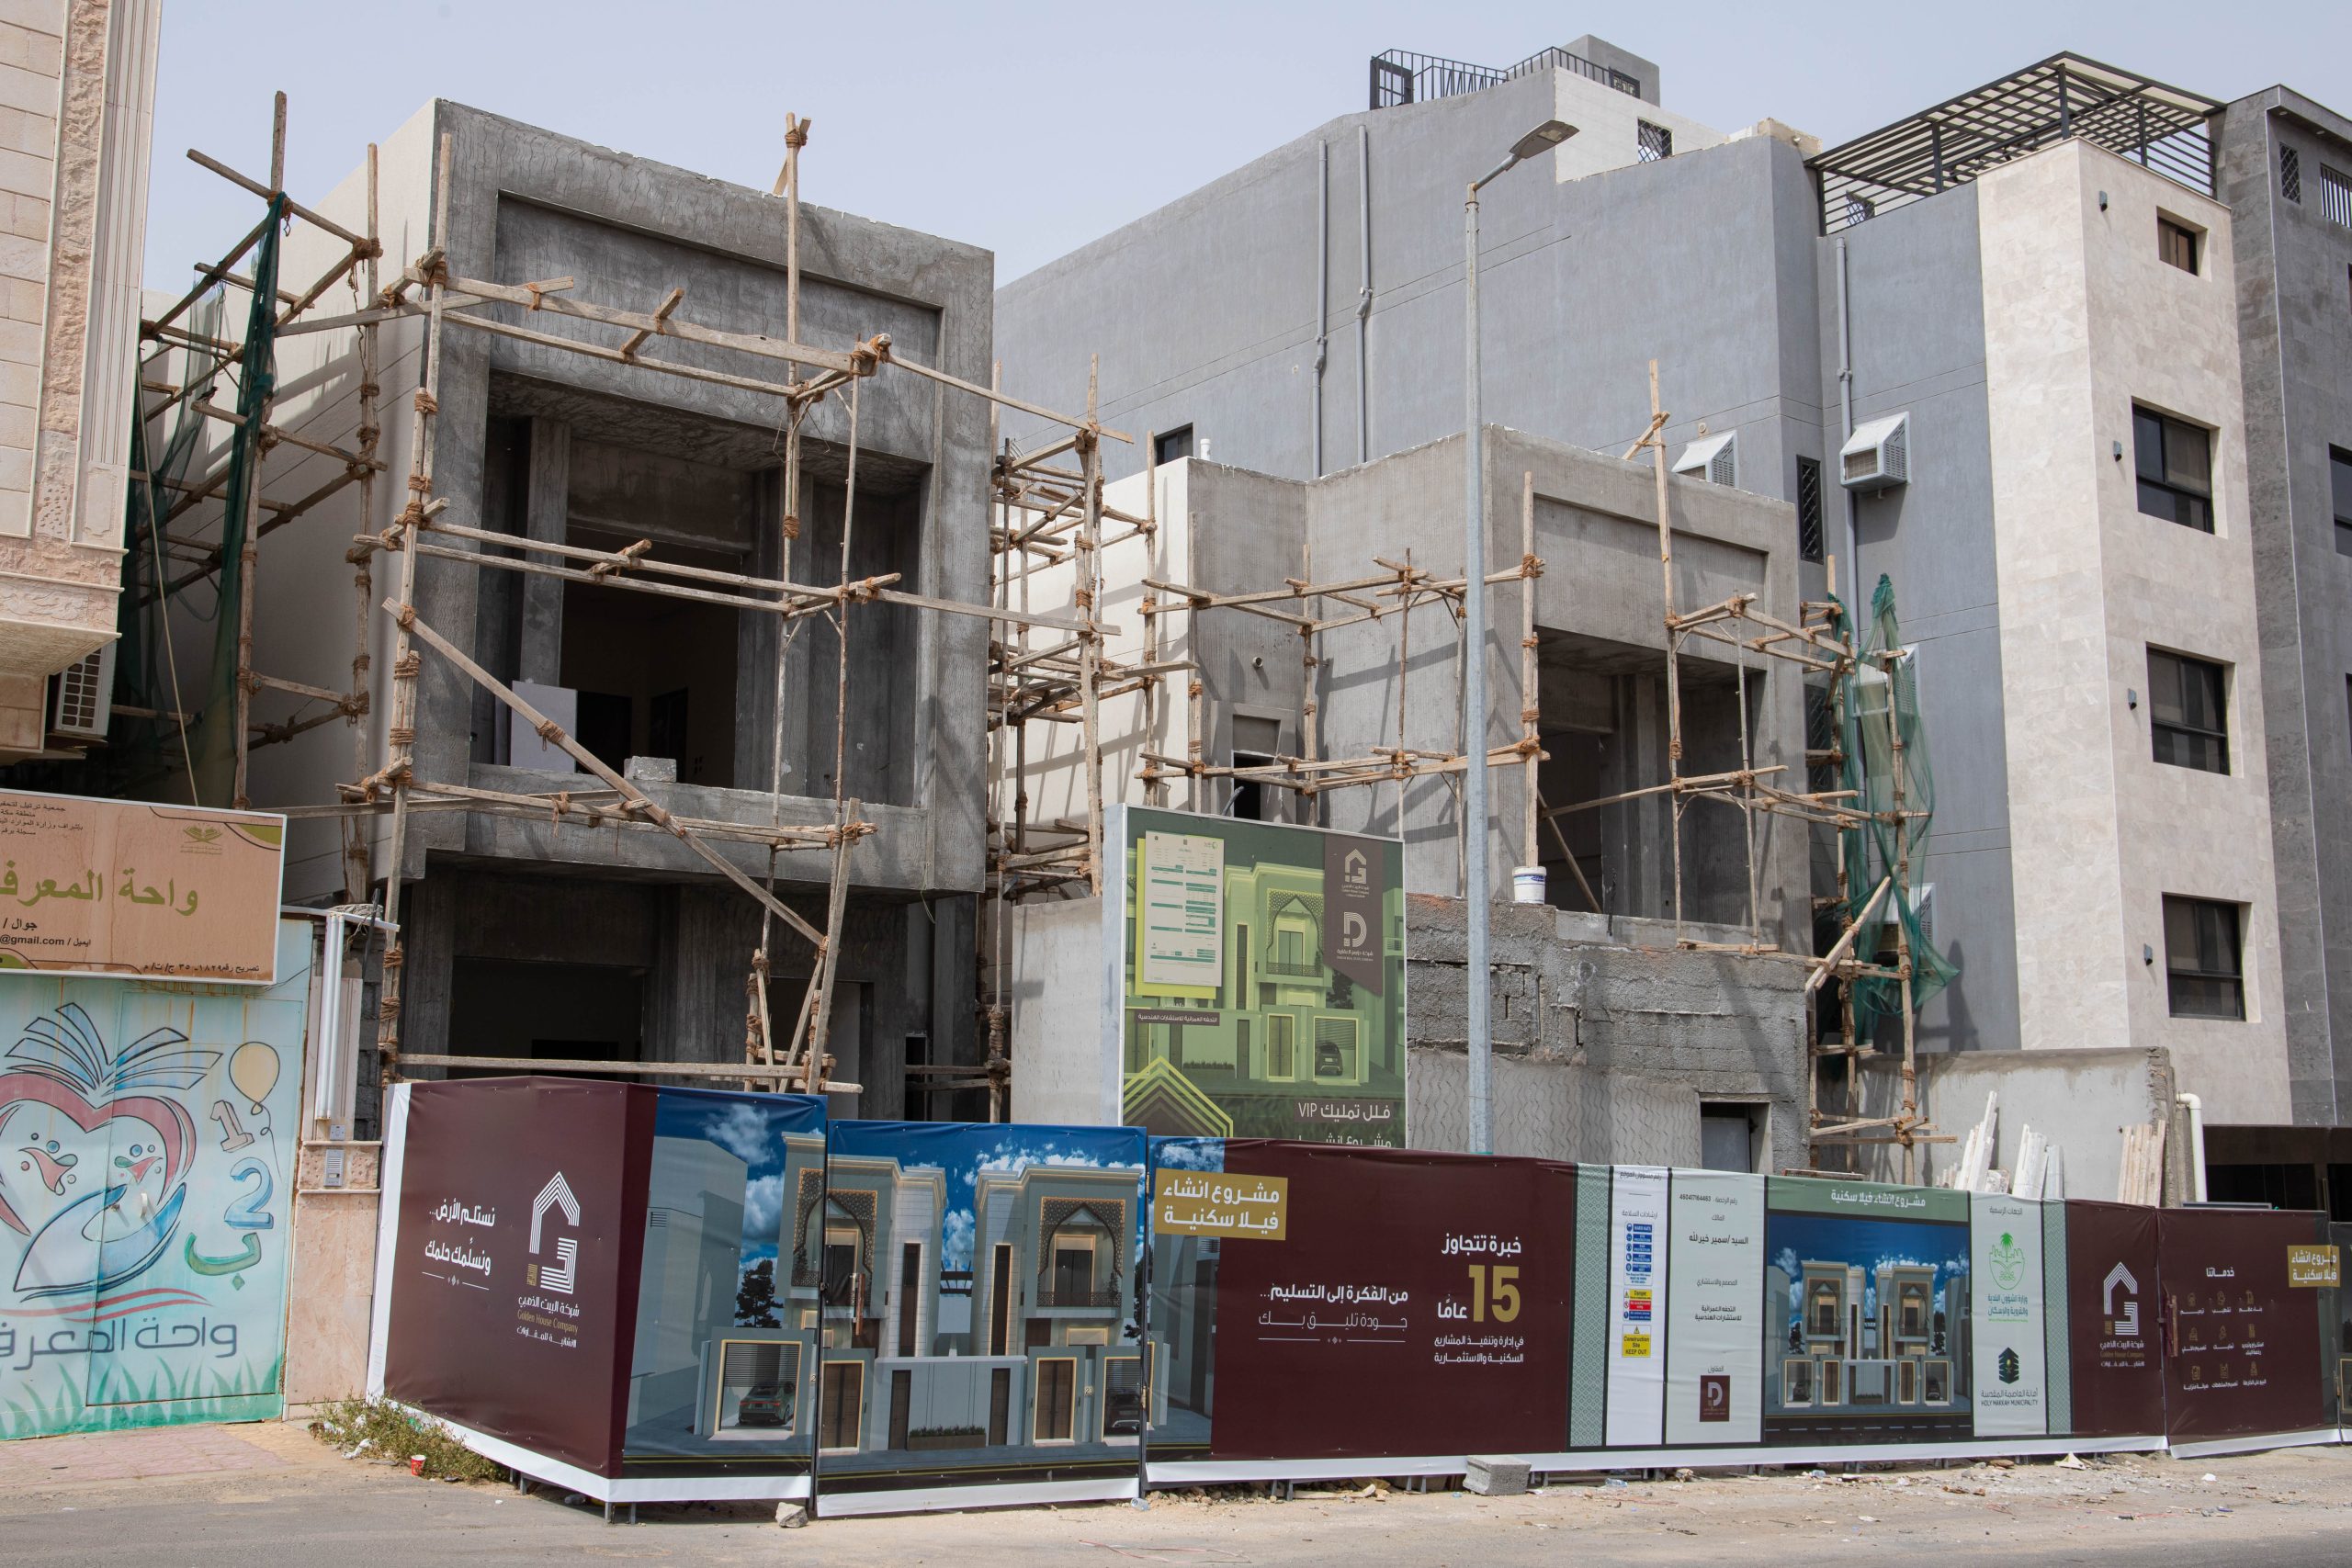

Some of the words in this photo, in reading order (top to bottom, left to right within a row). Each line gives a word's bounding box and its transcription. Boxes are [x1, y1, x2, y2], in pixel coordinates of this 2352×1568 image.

[0, 860, 103, 907] المعرف
[119, 867, 198, 917] واحة
[11, 918, 38, 931] جوال
[0, 934, 64, 945] @gmail.com
[1298, 1102, 1317, 1118] VIP
[1320, 1103, 1361, 1122] تمليك
[1363, 1104, 1391, 1122] فلل
[209, 1100, 254, 1153] 1
[223, 1157, 275, 1229] 2
[1163, 1177, 1209, 1199] انشاء
[1211, 1182, 1280, 1205] مشروع
[1831, 1189, 1858, 1203] سكنية
[1859, 1191, 1873, 1205] فيلا
[1874, 1192, 1894, 1204] انشاء
[1894, 1194, 1926, 1208] مشروع
[460, 1205, 495, 1226] نستلم
[1164, 1204, 1235, 1231] سكنية
[1238, 1211, 1279, 1235] فيلا
[424, 1240, 450, 1262] حلمك
[1441, 1233, 1487, 1257] تتجاوز
[1488, 1235, 1521, 1258] خبرة
[185, 1233, 262, 1291] ب
[2291, 1249, 2311, 1263] انشاء
[2206, 1267, 2234, 1277] خدماتنا
[2292, 1269, 2323, 1283] سكنية
[518, 1295, 540, 1308] الذهبي
[1327, 1285, 1345, 1303] إلى
[1346, 1284, 1387, 1303] الفكرة
[1388, 1291, 1408, 1304] من
[1468, 1264, 1521, 1323] 15
[540, 1298, 560, 1314] البيت
[560, 1303, 580, 1318] شركة
[517, 1309, 535, 1323] Golden
[536, 1314, 552, 1327] House
[553, 1317, 579, 1335] Company
[1259, 1310, 1306, 1329] بك
[1307, 1311, 1359, 1330] تليق
[1360, 1313, 1408, 1332] جودة
[0, 1318, 126, 1371] المعرف
[135, 1316, 237, 1358] واحة
[1434, 1333, 1466, 1348] المشاريع
[1467, 1335, 1498, 1348] وتنفيذ
[1498, 1336, 1514, 1348] إدارة
[1515, 1336, 1524, 1350] في
[1434, 1350, 1487, 1365] والاستثمارية
[1487, 1352, 1524, 1365] السكنية
